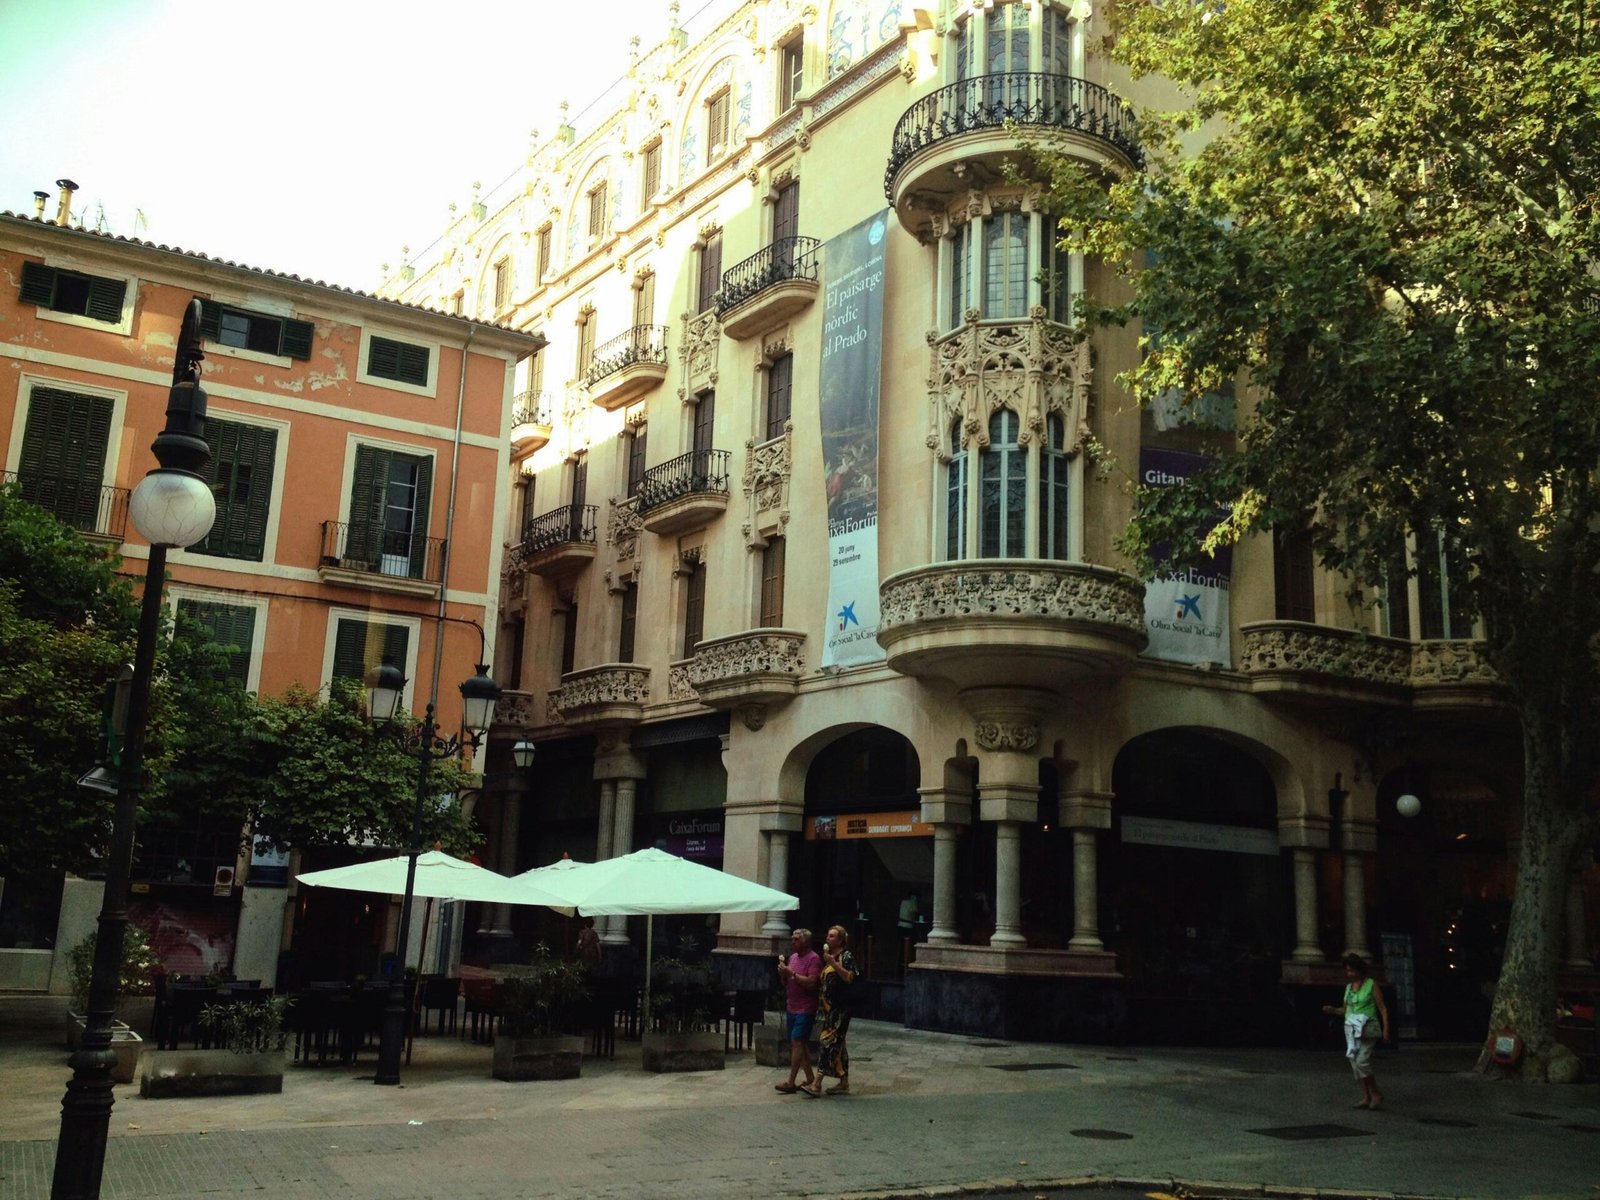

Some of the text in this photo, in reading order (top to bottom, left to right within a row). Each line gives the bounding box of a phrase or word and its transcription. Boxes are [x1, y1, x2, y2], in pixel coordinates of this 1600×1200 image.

[826, 287, 838, 310] El
[840, 271, 882, 307] paisatge
[822, 325, 868, 358] al Prado
[1169, 566, 1229, 590] xaForum
[669, 818, 721, 835] CaixaForum
